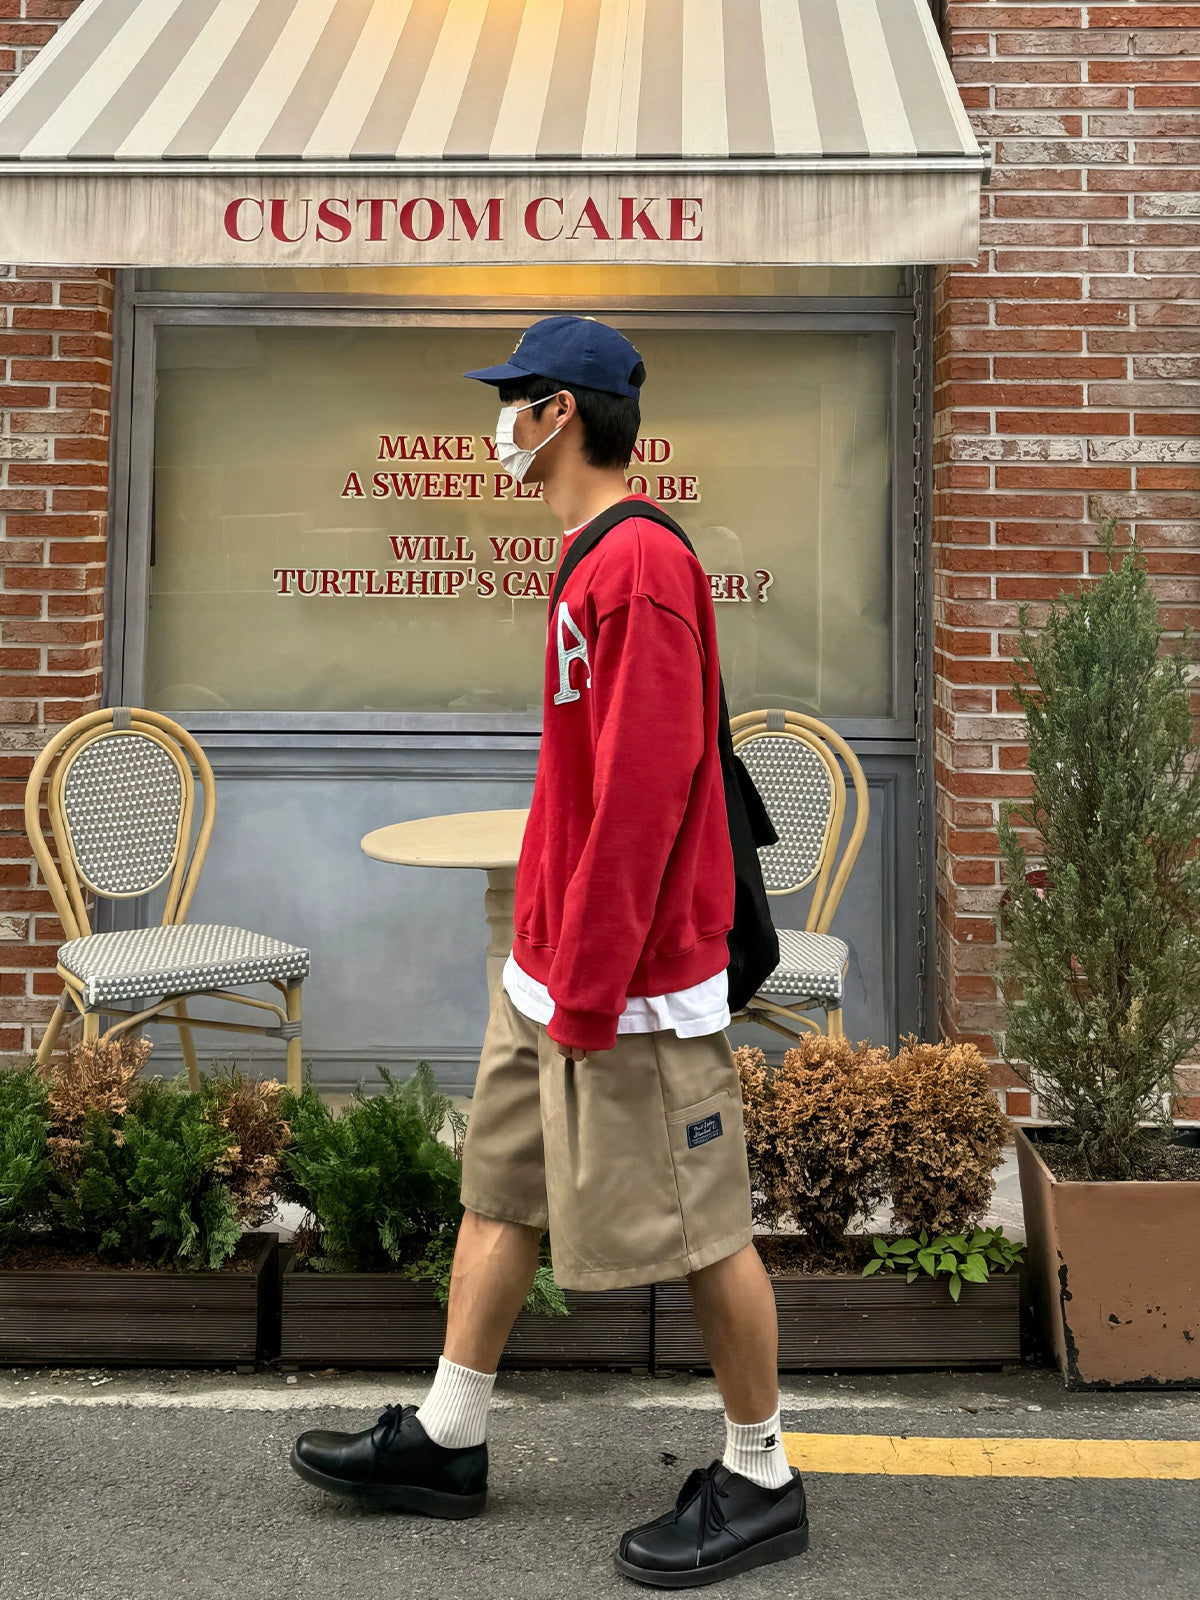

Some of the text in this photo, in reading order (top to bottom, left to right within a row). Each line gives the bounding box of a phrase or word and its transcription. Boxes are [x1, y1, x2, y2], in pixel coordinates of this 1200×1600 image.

[223, 197, 704, 243] CUSTOM CAKE
[376, 435, 477, 462] MAKE
[341, 472, 365, 498] A
[371, 472, 486, 499] SWEET
[655, 475, 699, 501] BE
[388, 535, 557, 562] WILL YOU
[273, 567, 497, 598] TURTLEHIP'S
